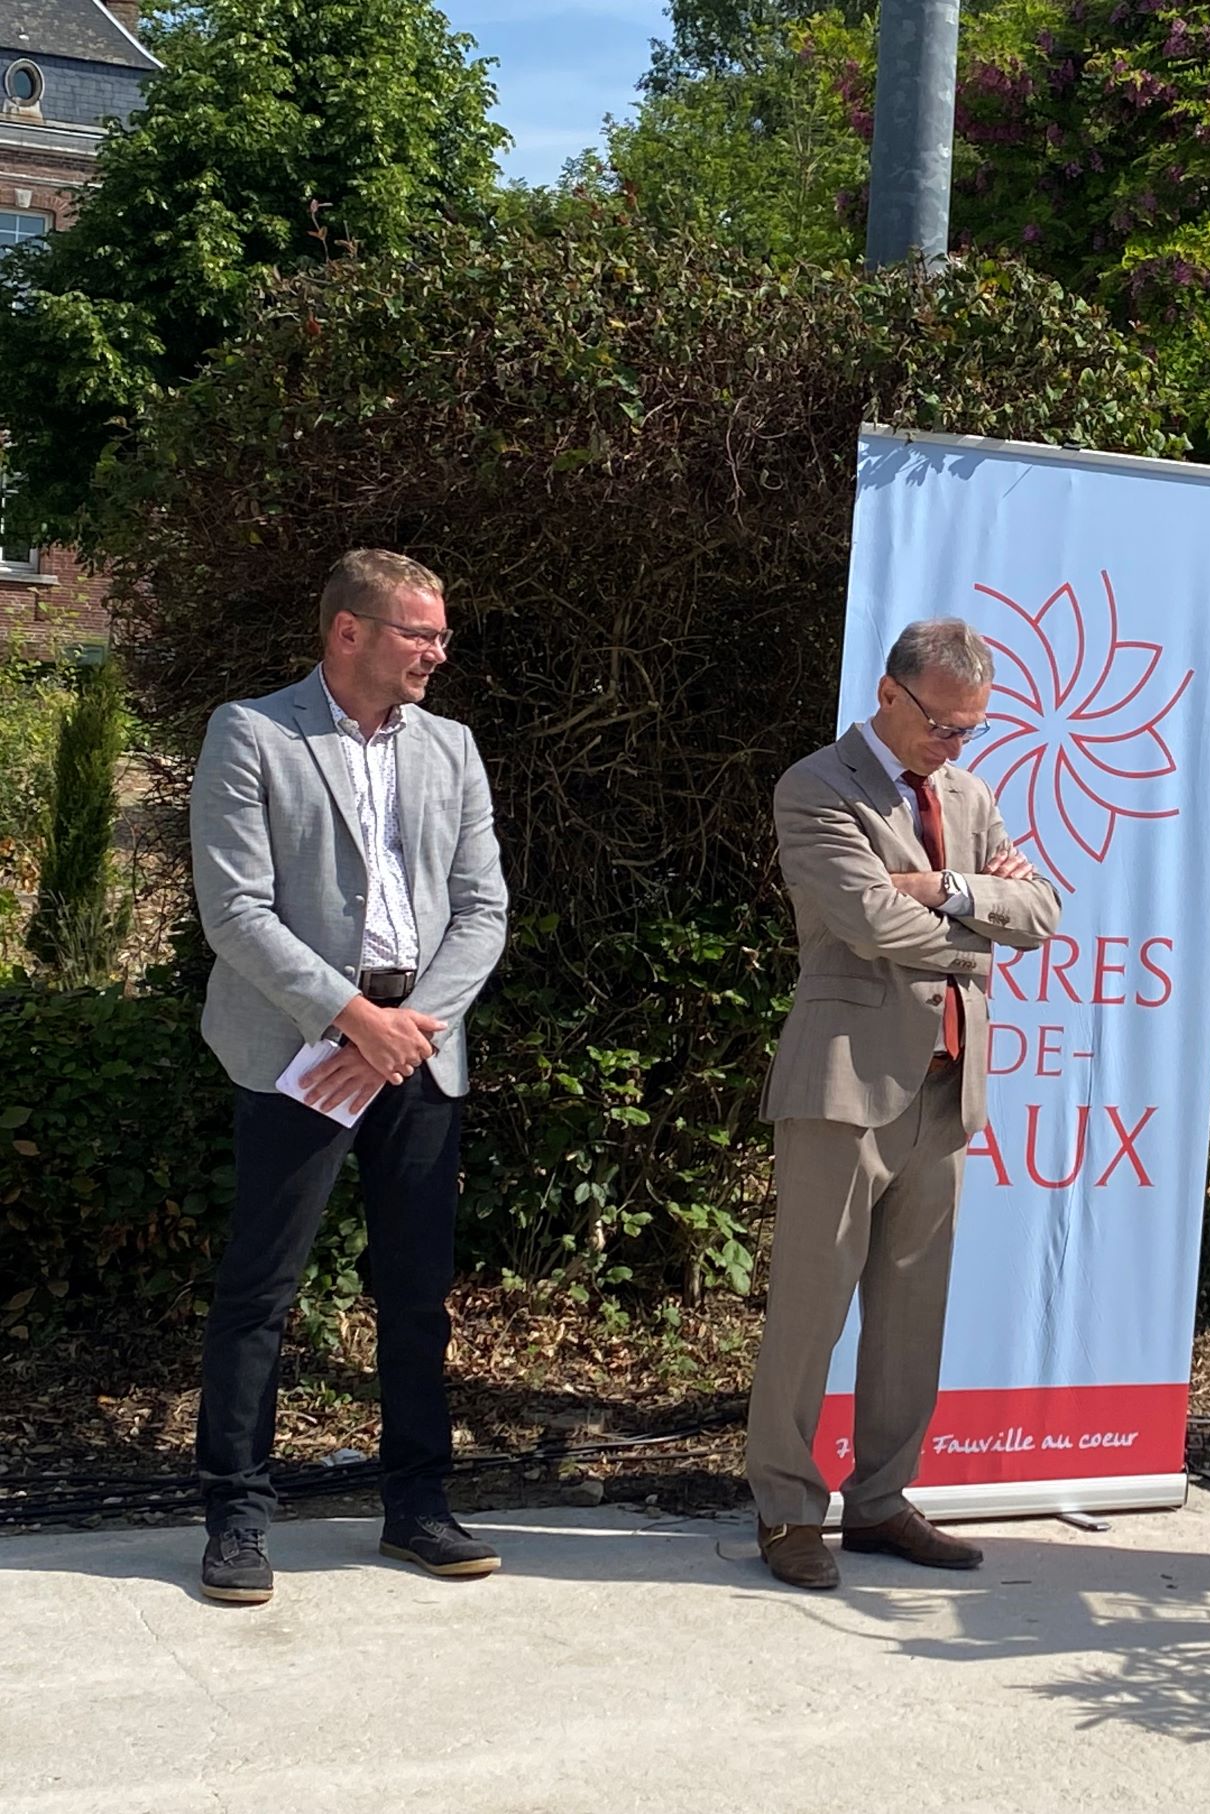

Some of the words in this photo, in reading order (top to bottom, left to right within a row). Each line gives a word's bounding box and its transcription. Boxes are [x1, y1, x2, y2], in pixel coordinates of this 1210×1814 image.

[985, 933, 1174, 1008] RRES
[966, 1103, 1159, 1189] AUX
[932, 1427, 1036, 1455] Fauville
[1041, 1432, 1074, 1450] au
[1077, 1431, 1139, 1449] coeur
